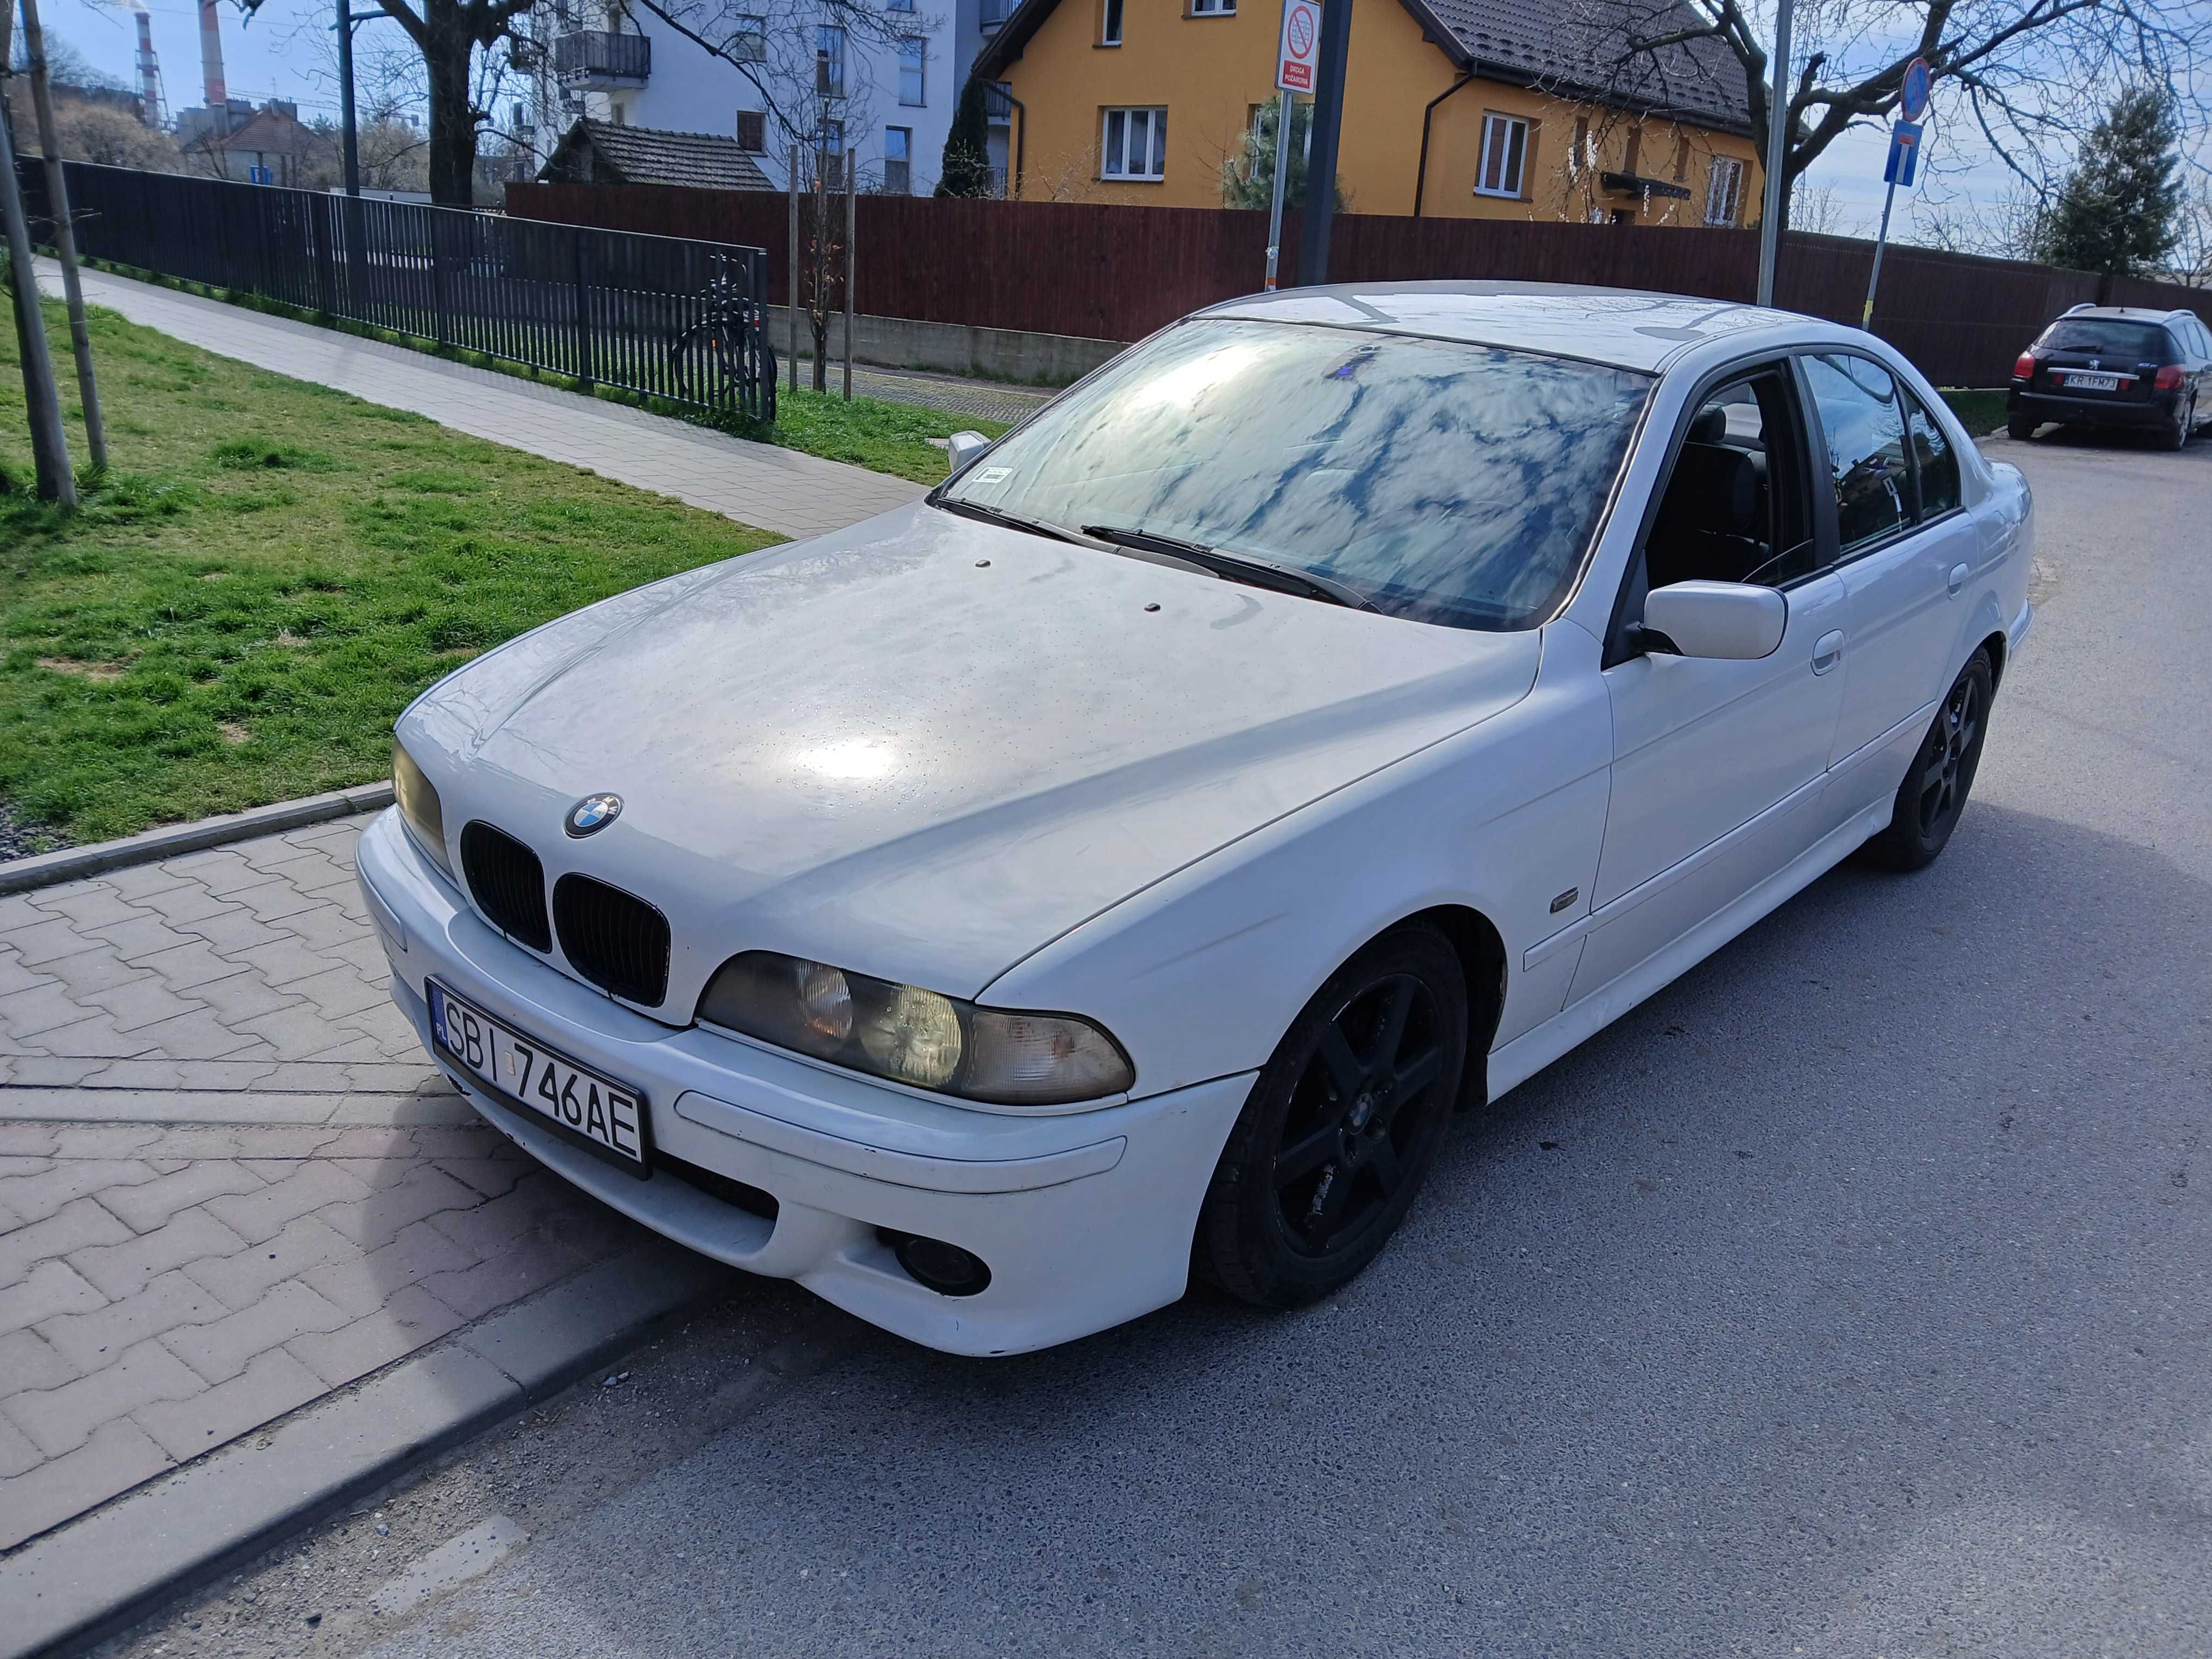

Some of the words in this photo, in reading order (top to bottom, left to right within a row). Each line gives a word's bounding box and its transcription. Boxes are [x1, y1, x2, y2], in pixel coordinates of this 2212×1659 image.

[1290, 65, 1304, 74] DROGA
[2070, 375, 2084, 385] KR
[2088, 377, 2117, 388] 1FM73
[436, 1022, 447, 1041] PL
[446, 1002, 497, 1082] SBI
[513, 1043, 638, 1159] 746AE
